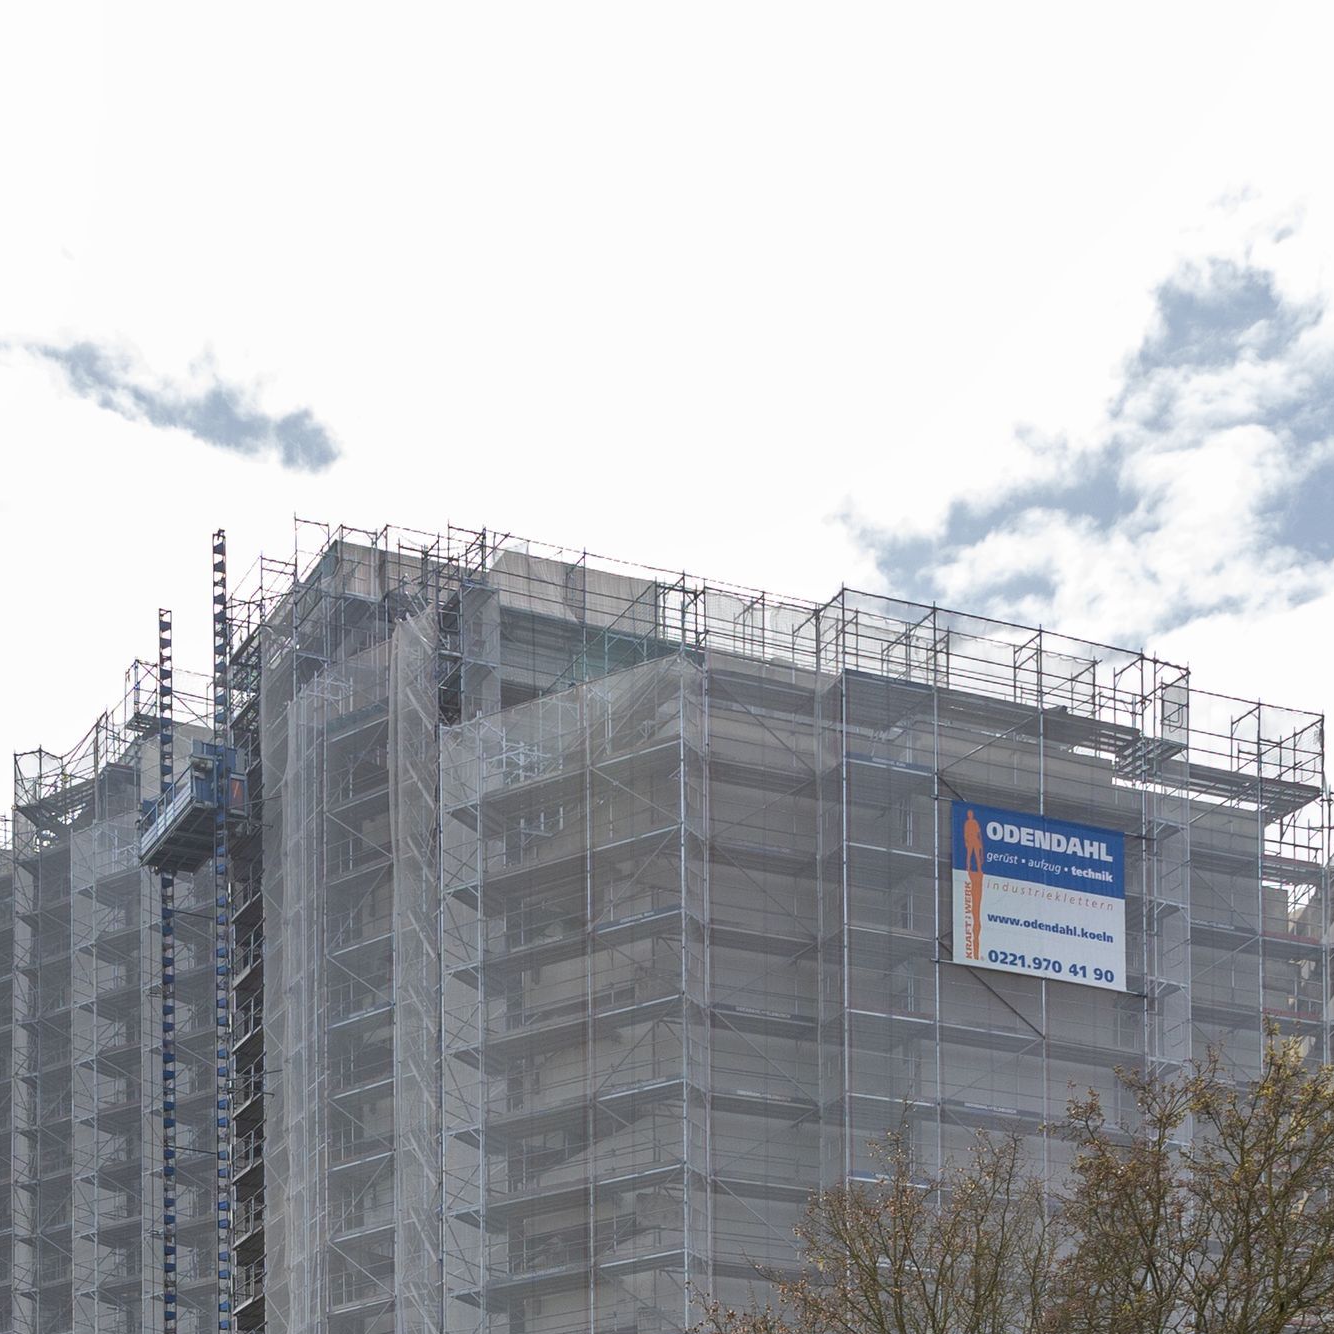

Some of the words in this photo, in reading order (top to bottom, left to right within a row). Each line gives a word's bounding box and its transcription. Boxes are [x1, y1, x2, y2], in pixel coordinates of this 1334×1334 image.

[986, 821, 1113, 862] ODENDAHL
[986, 852, 1018, 865] gerüst
[1028, 859, 1062, 875] aufzug
[1071, 866, 1114, 883] technik
[986, 879, 1114, 911] industrieklettern
[987, 913, 1114, 943] www.odendahl.koeln
[988, 949, 1063, 974] 0221.970
[1069, 964, 1087, 979] 41
[1093, 967, 1115, 983] 90
